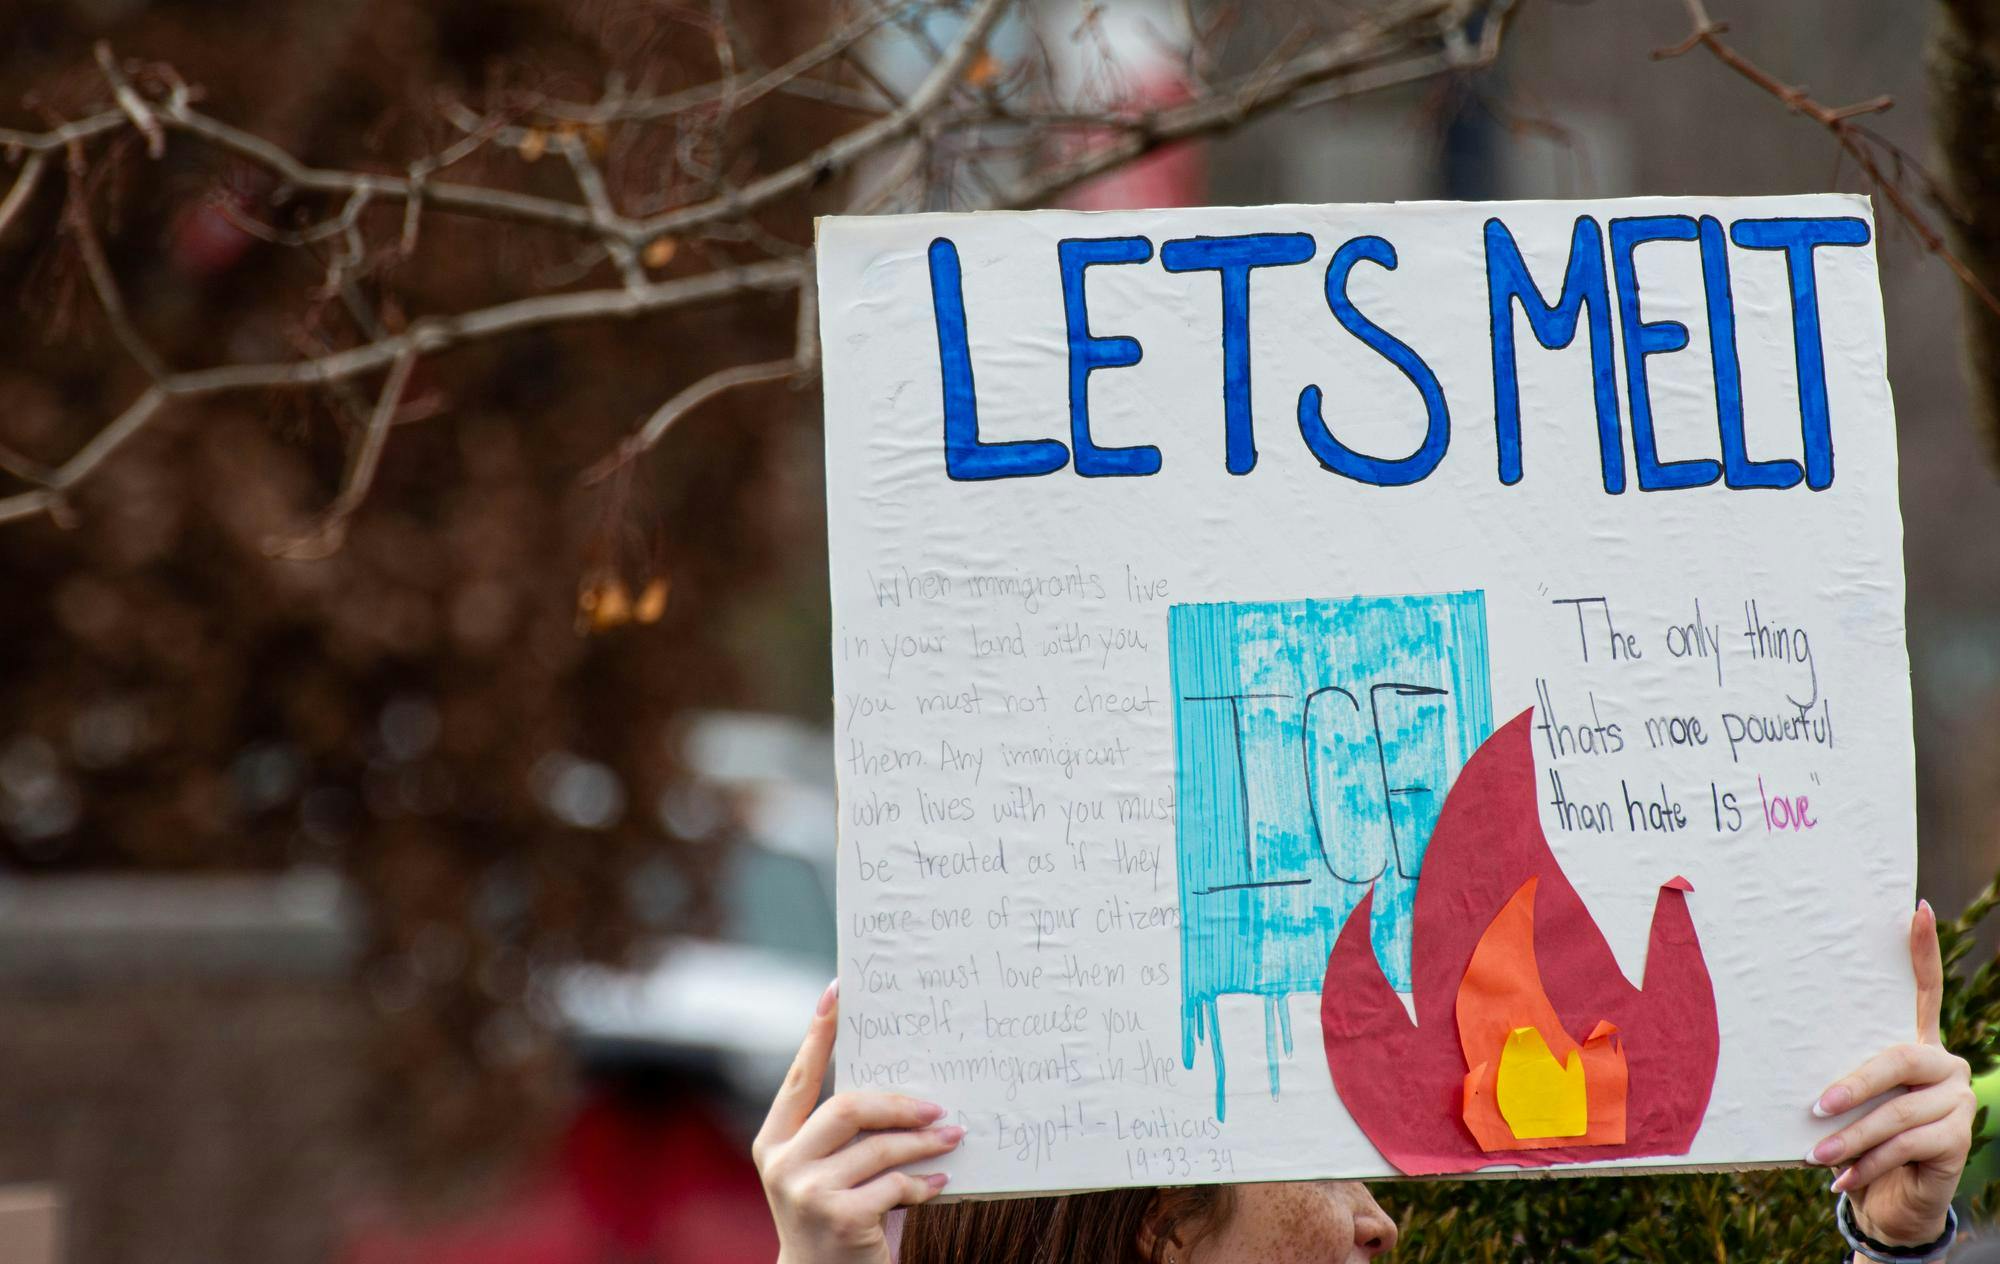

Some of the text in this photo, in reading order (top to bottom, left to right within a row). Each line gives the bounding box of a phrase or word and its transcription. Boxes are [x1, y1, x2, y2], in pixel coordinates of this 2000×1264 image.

[929, 214, 1872, 495] LETS MELT
[867, 563, 1169, 615] When immigrants live
[842, 625, 869, 661] in
[881, 633, 947, 680] your
[970, 622, 1027, 659] land
[1043, 621, 1091, 657] with
[1666, 597, 1723, 688] only
[1743, 598, 1818, 709] thing
[846, 682, 1160, 731] you must not cheat
[1536, 677, 1833, 763] thats more powerful
[940, 739, 984, 787] Any
[999, 735, 1131, 780] immigrant
[1183, 682, 1449, 895] ICE
[851, 784, 1176, 846] who lives with you must
[1550, 767, 1614, 833] than
[1621, 779, 1688, 833] hate
[856, 836, 1161, 895] be treated as if they
[852, 906, 913, 939] were
[930, 902, 974, 932] one
[987, 896, 1010, 929] of
[1029, 904, 1080, 953] your
[852, 951, 1171, 995] You must love them as
[984, 999, 1088, 1039] because
[1101, 1007, 1146, 1055] you
[850, 1039, 1176, 1101] were immigrants in the
